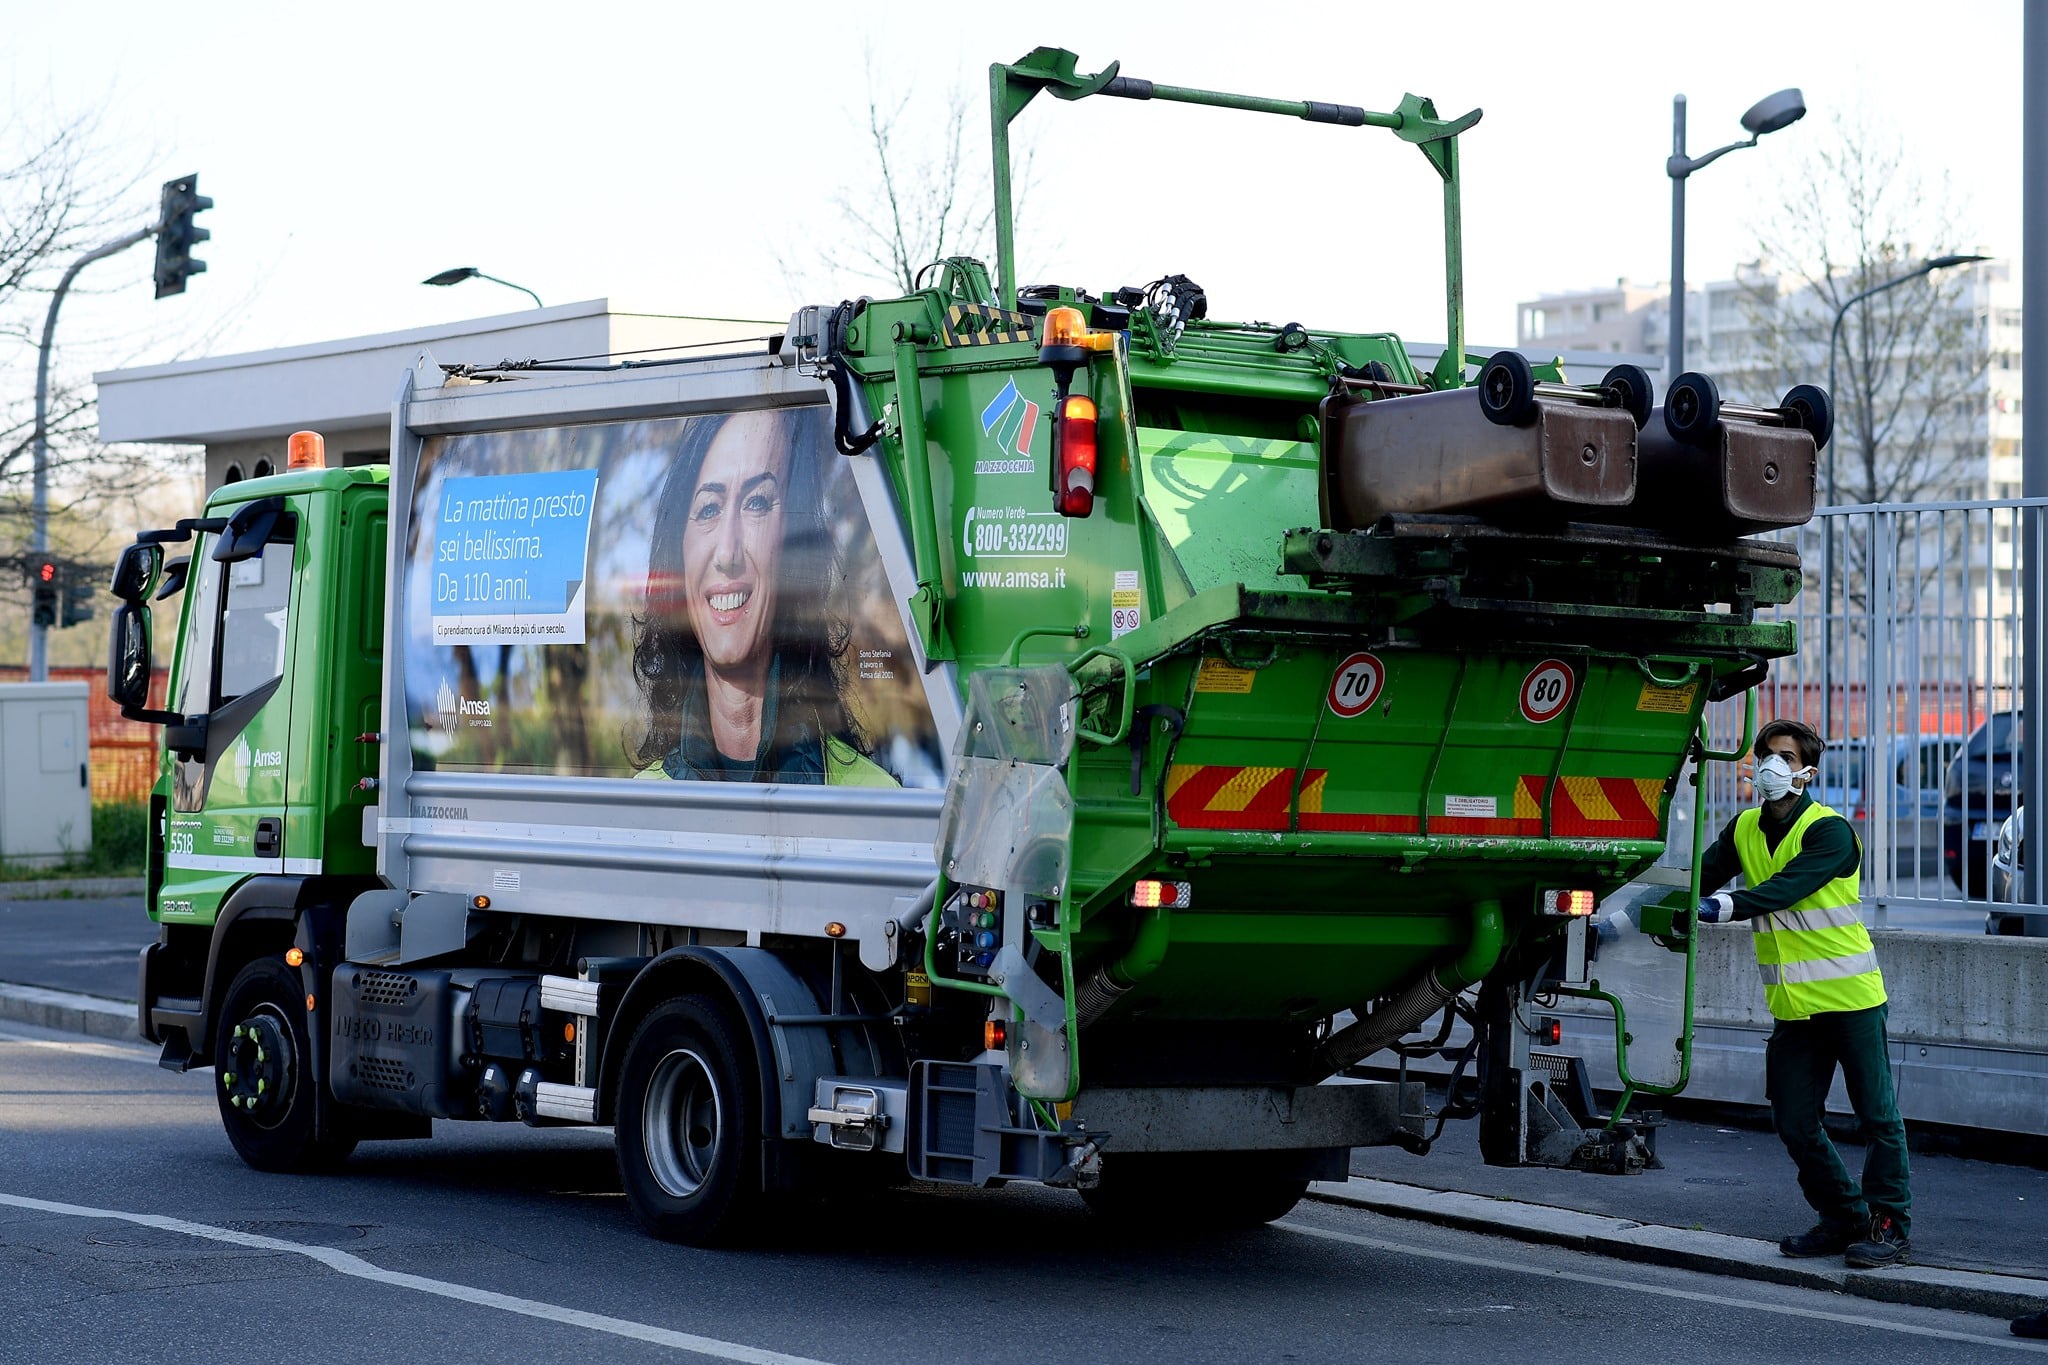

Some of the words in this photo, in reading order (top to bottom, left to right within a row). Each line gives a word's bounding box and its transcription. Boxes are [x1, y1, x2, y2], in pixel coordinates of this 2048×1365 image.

[975, 460, 1034, 474] MAZZOCCHIA
[444, 494, 463, 523] La
[466, 491, 529, 522] mattina
[531, 490, 586, 528] presto
[976, 507, 1004, 519] Numero
[1005, 506, 1026, 519] Verde
[439, 532, 461, 562] sei
[463, 529, 543, 561] bellissima.
[975, 523, 1065, 551] 800-332299
[437, 572, 458, 602] Da
[464, 572, 491, 602] 110
[494, 569, 531, 601] anni.
[962, 567, 1066, 588] www.amsa.it
[437, 625, 444, 635] Ci
[444, 624, 472, 637] prendiamo
[473, 626, 486, 635] cura
[486, 624, 492, 635] di
[493, 624, 512, 635] Milano
[513, 624, 520, 634] da
[531, 624, 537, 634] di
[537, 625, 545, 634] un
[546, 623, 567, 634] secolo.
[860, 650, 871, 658] Sono
[872, 649, 891, 658] Stefania
[860, 671, 873, 679] Amsa
[864, 661, 878, 669] lavoro
[1342, 672, 1370, 697] 70
[1533, 678, 1562, 702] 80
[460, 695, 490, 715] Amsa
[253, 748, 282, 768] Amsa
[413, 805, 469, 820] MAZZOCCHIA
[170, 832, 194, 854] 5518
[336, 1015, 381, 1041] IVECO
